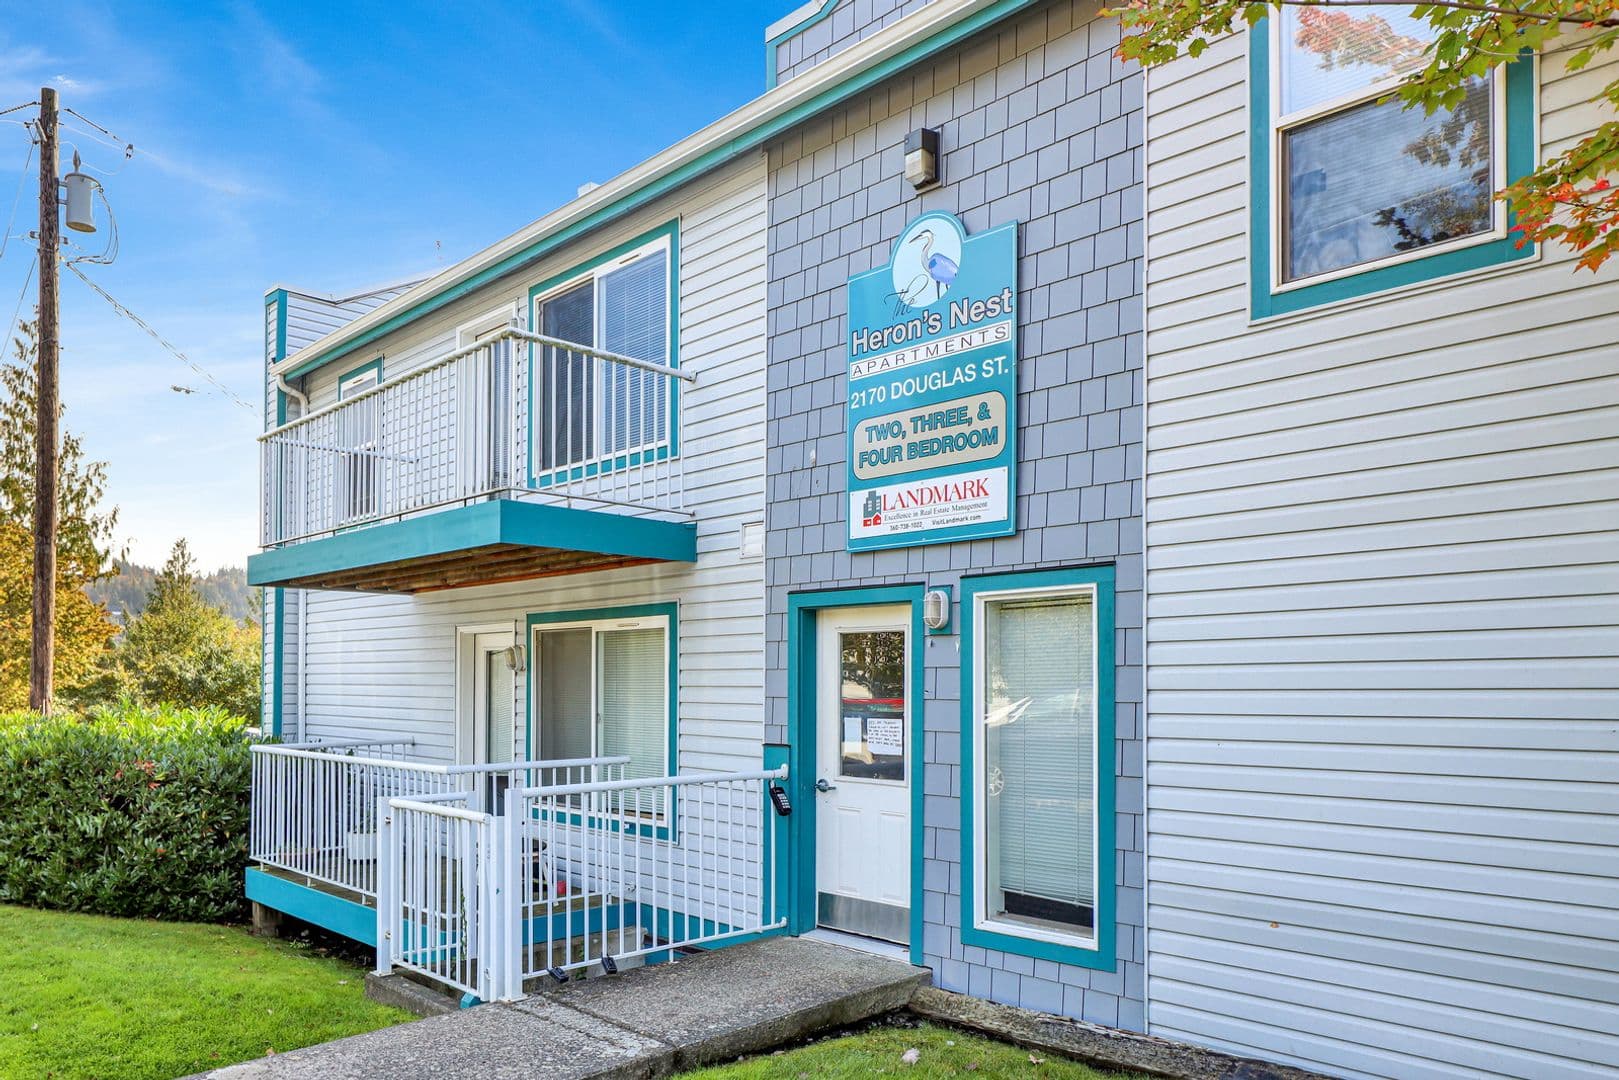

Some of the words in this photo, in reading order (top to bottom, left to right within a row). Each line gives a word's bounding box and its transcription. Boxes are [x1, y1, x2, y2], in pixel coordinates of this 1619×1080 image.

[851, 309, 942, 356] Heron's
[949, 287, 1013, 330] Nest
[852, 326, 1007, 376] APARTMENTS
[851, 386, 886, 409] 2170
[891, 364, 976, 399] DOUGLAS
[981, 356, 1009, 378] ST.
[865, 420, 907, 443] TWO,
[910, 405, 973, 434] THREE,
[976, 402, 991, 421] &
[858, 445, 903, 469] FOUR
[907, 426, 999, 461] BEDROOM
[883, 477, 990, 512] LANDMARK
[884, 511, 912, 521] Excellence
[920, 508, 933, 516] Real
[933, 506, 950, 515] Estate
[951, 501, 988, 512] Management
